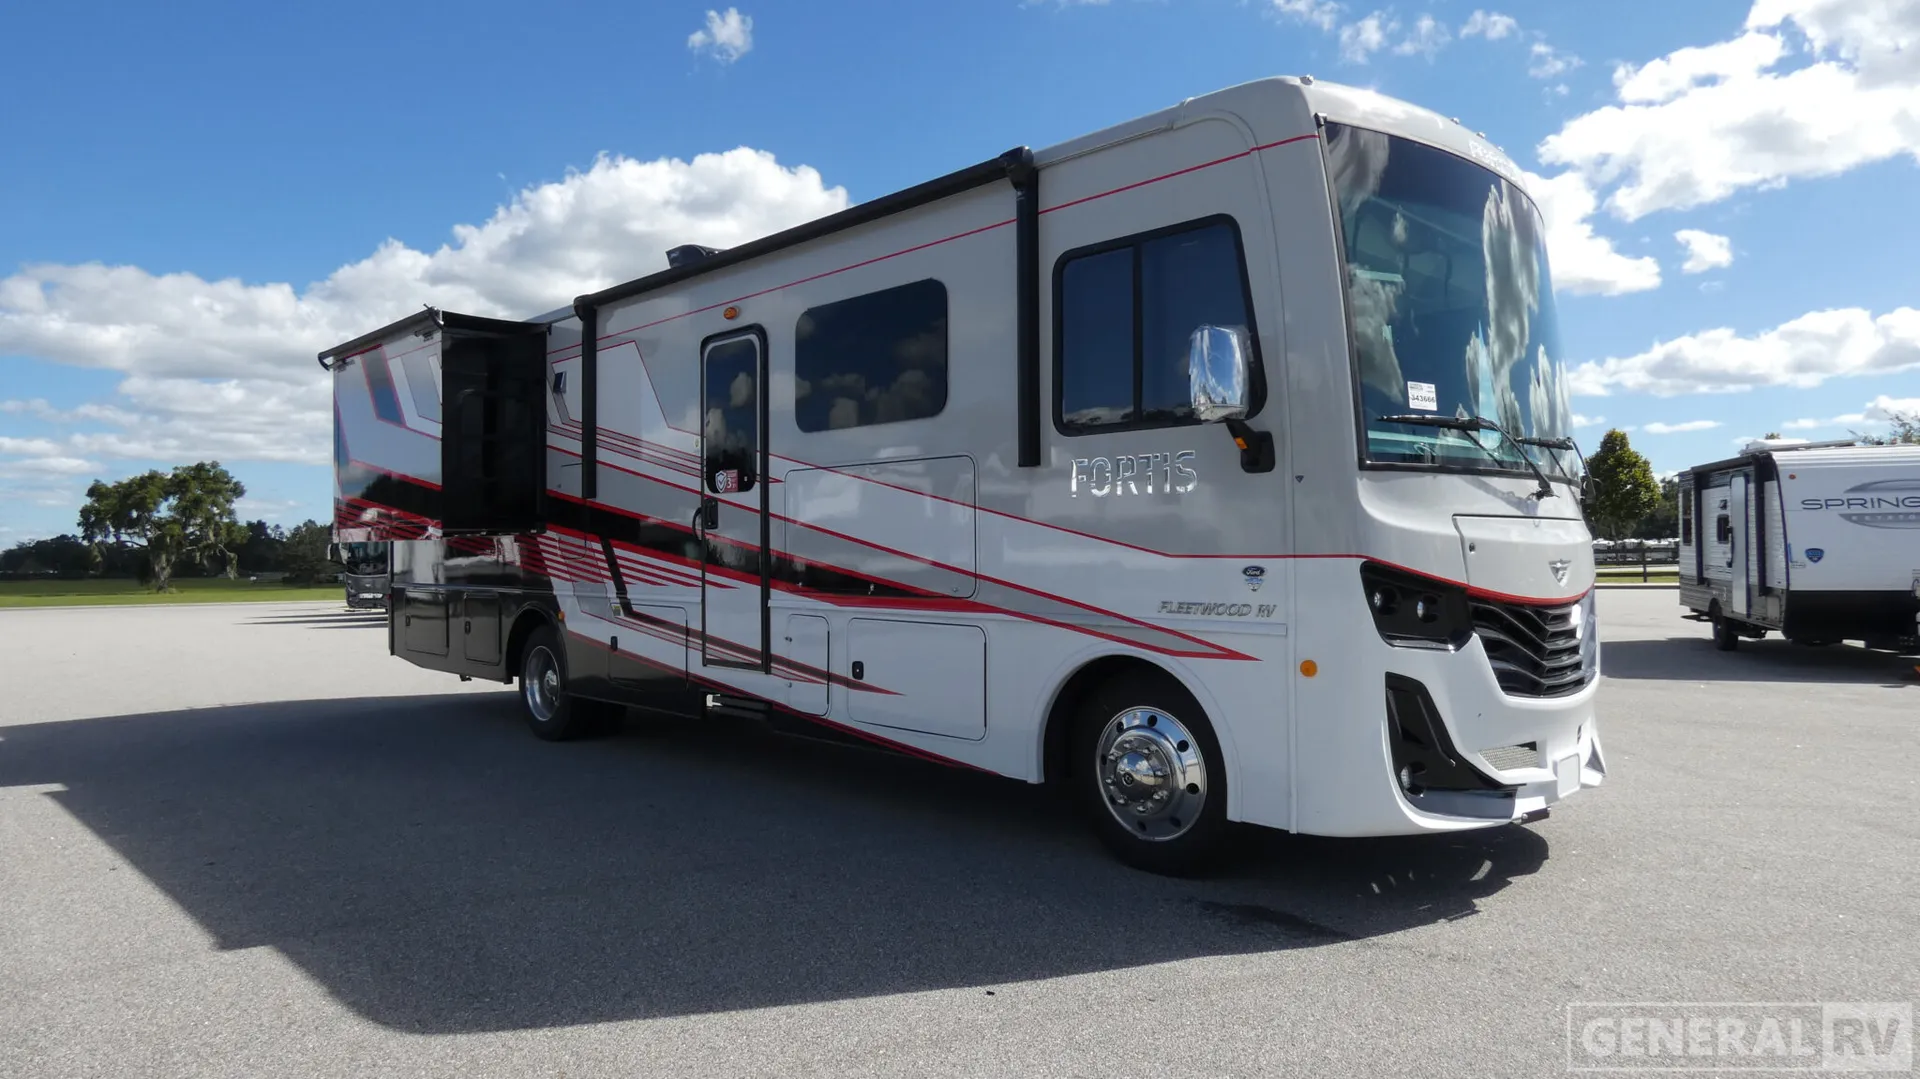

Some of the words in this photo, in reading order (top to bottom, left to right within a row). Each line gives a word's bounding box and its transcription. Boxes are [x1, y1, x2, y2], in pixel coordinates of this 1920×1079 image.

[1071, 450, 1198, 498] FORTIS
[1801, 496, 1920, 510] SPRING
[1245, 568, 1261, 576] Ford
[1158, 601, 1252, 617] FLEETWOOD
[1256, 604, 1278, 618] RV
